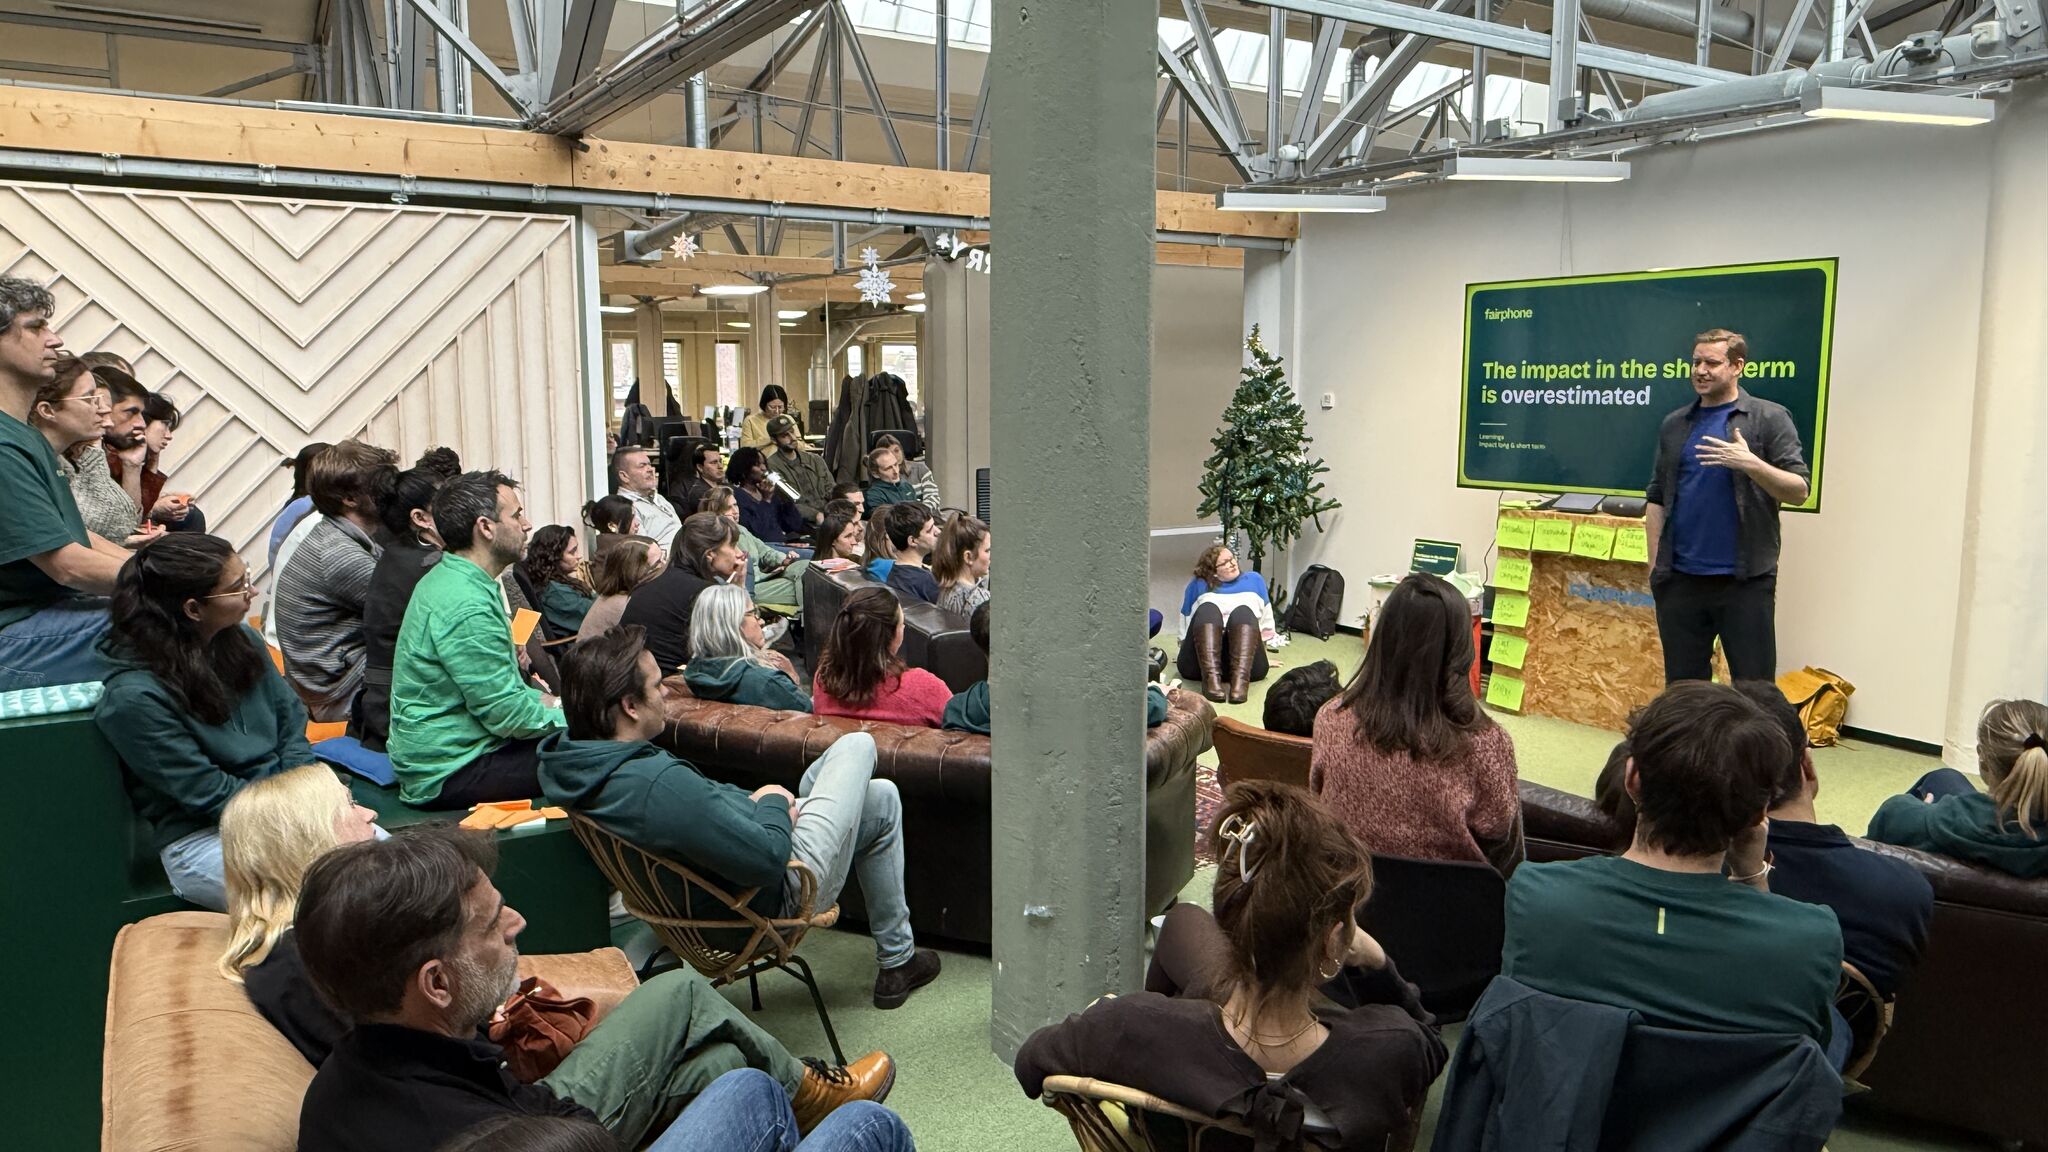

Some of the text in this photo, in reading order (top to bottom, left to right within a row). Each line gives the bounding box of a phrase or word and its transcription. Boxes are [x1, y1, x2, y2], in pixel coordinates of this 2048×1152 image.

[1484, 307, 1533, 322] fairphone
[1482, 361, 1517, 380] The
[1521, 359, 1591, 383] impact
[1595, 358, 1615, 379] in
[1620, 358, 1657, 379] the
[1739, 360, 1796, 378] erm
[1481, 384, 1651, 405] is overestimated
